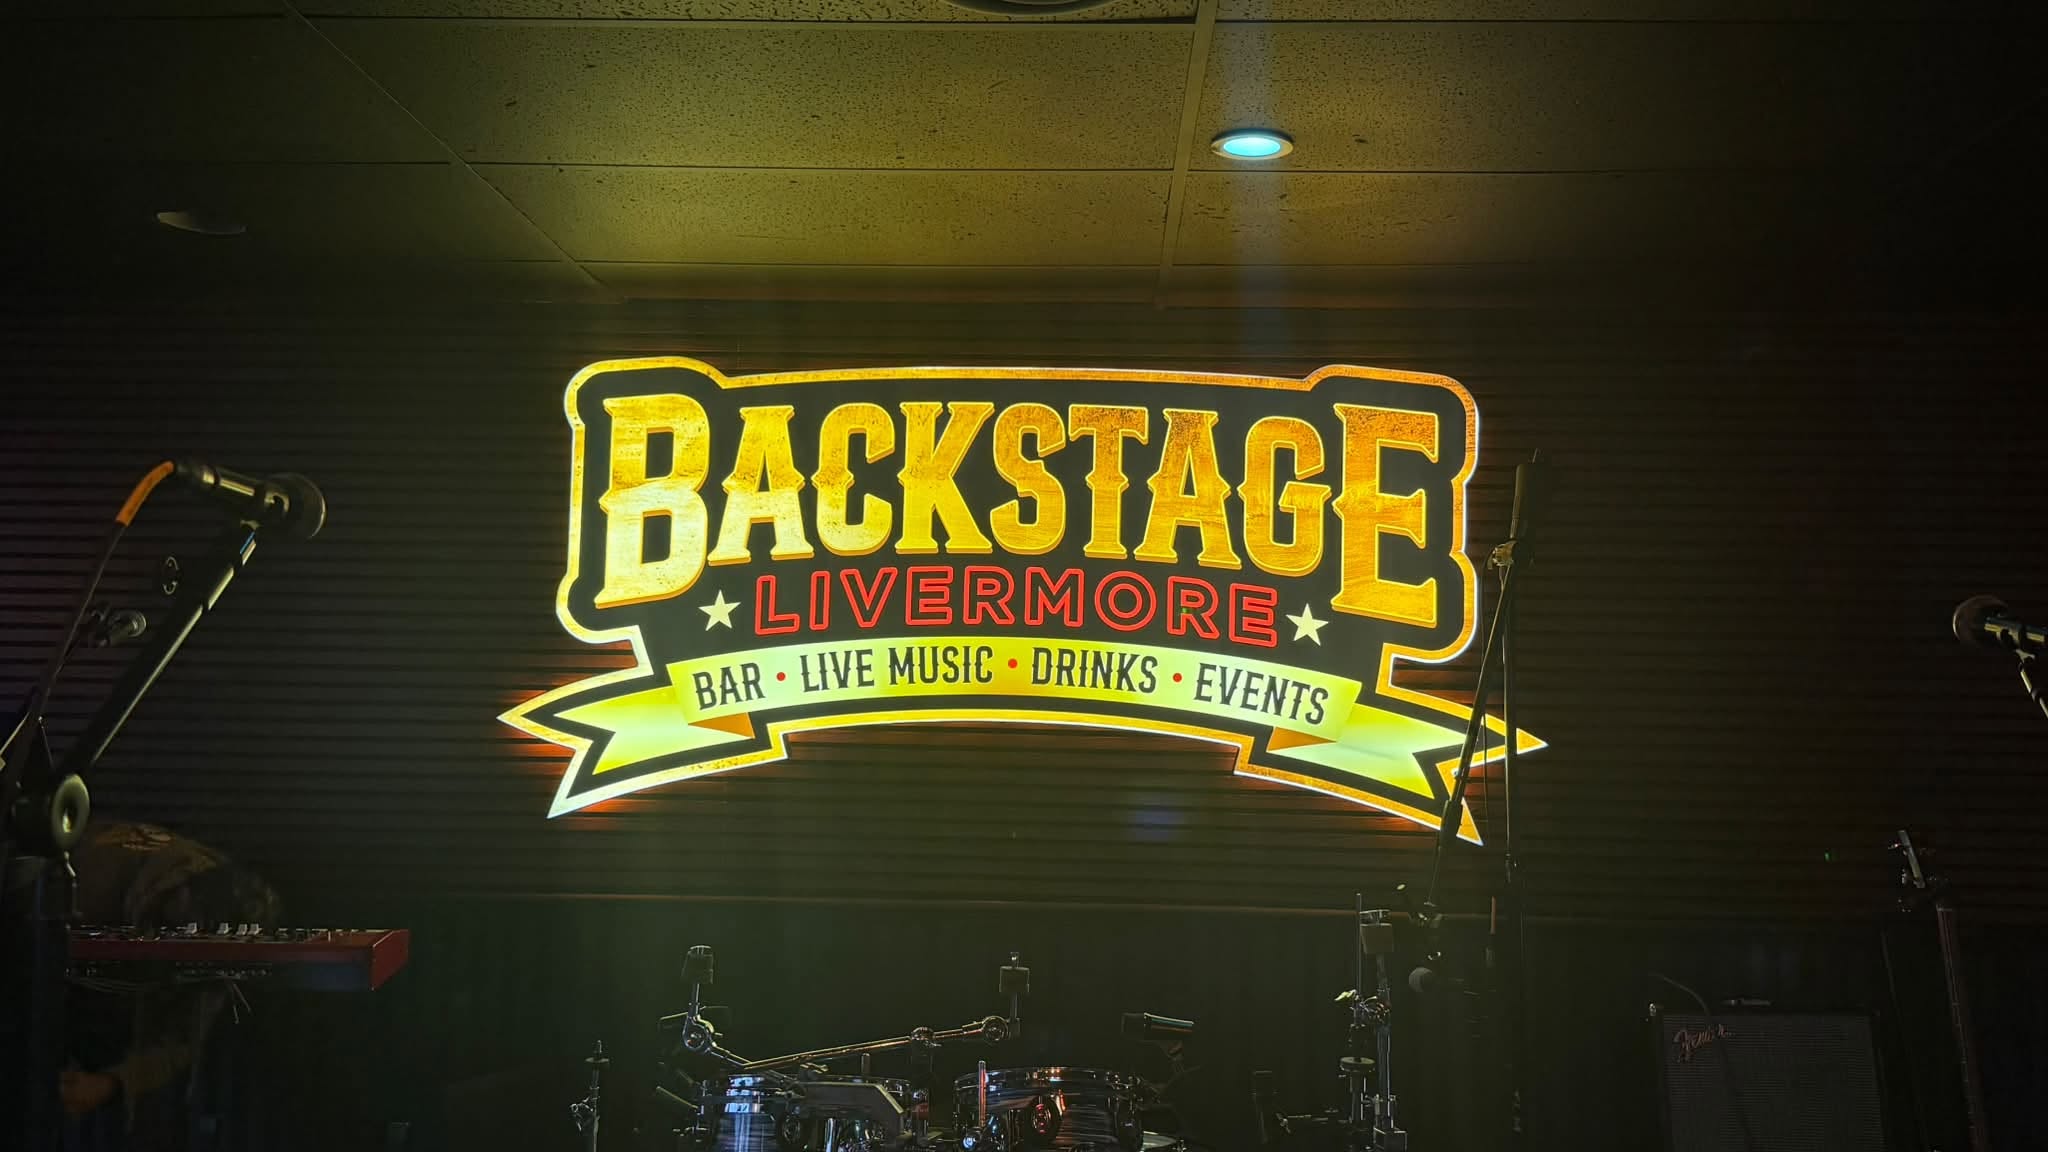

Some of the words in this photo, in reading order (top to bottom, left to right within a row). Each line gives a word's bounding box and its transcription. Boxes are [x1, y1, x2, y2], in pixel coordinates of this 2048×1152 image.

[594, 393, 1440, 628] BACKSTAGE
[753, 564, 1281, 648] LIVERMORE
[692, 661, 765, 711] BAR
[800, 648, 875, 693] LIVE
[888, 645, 993, 686] MUSIC
[1031, 647, 1158, 694] DRINKS
[1194, 662, 1329, 725] EVENTS
